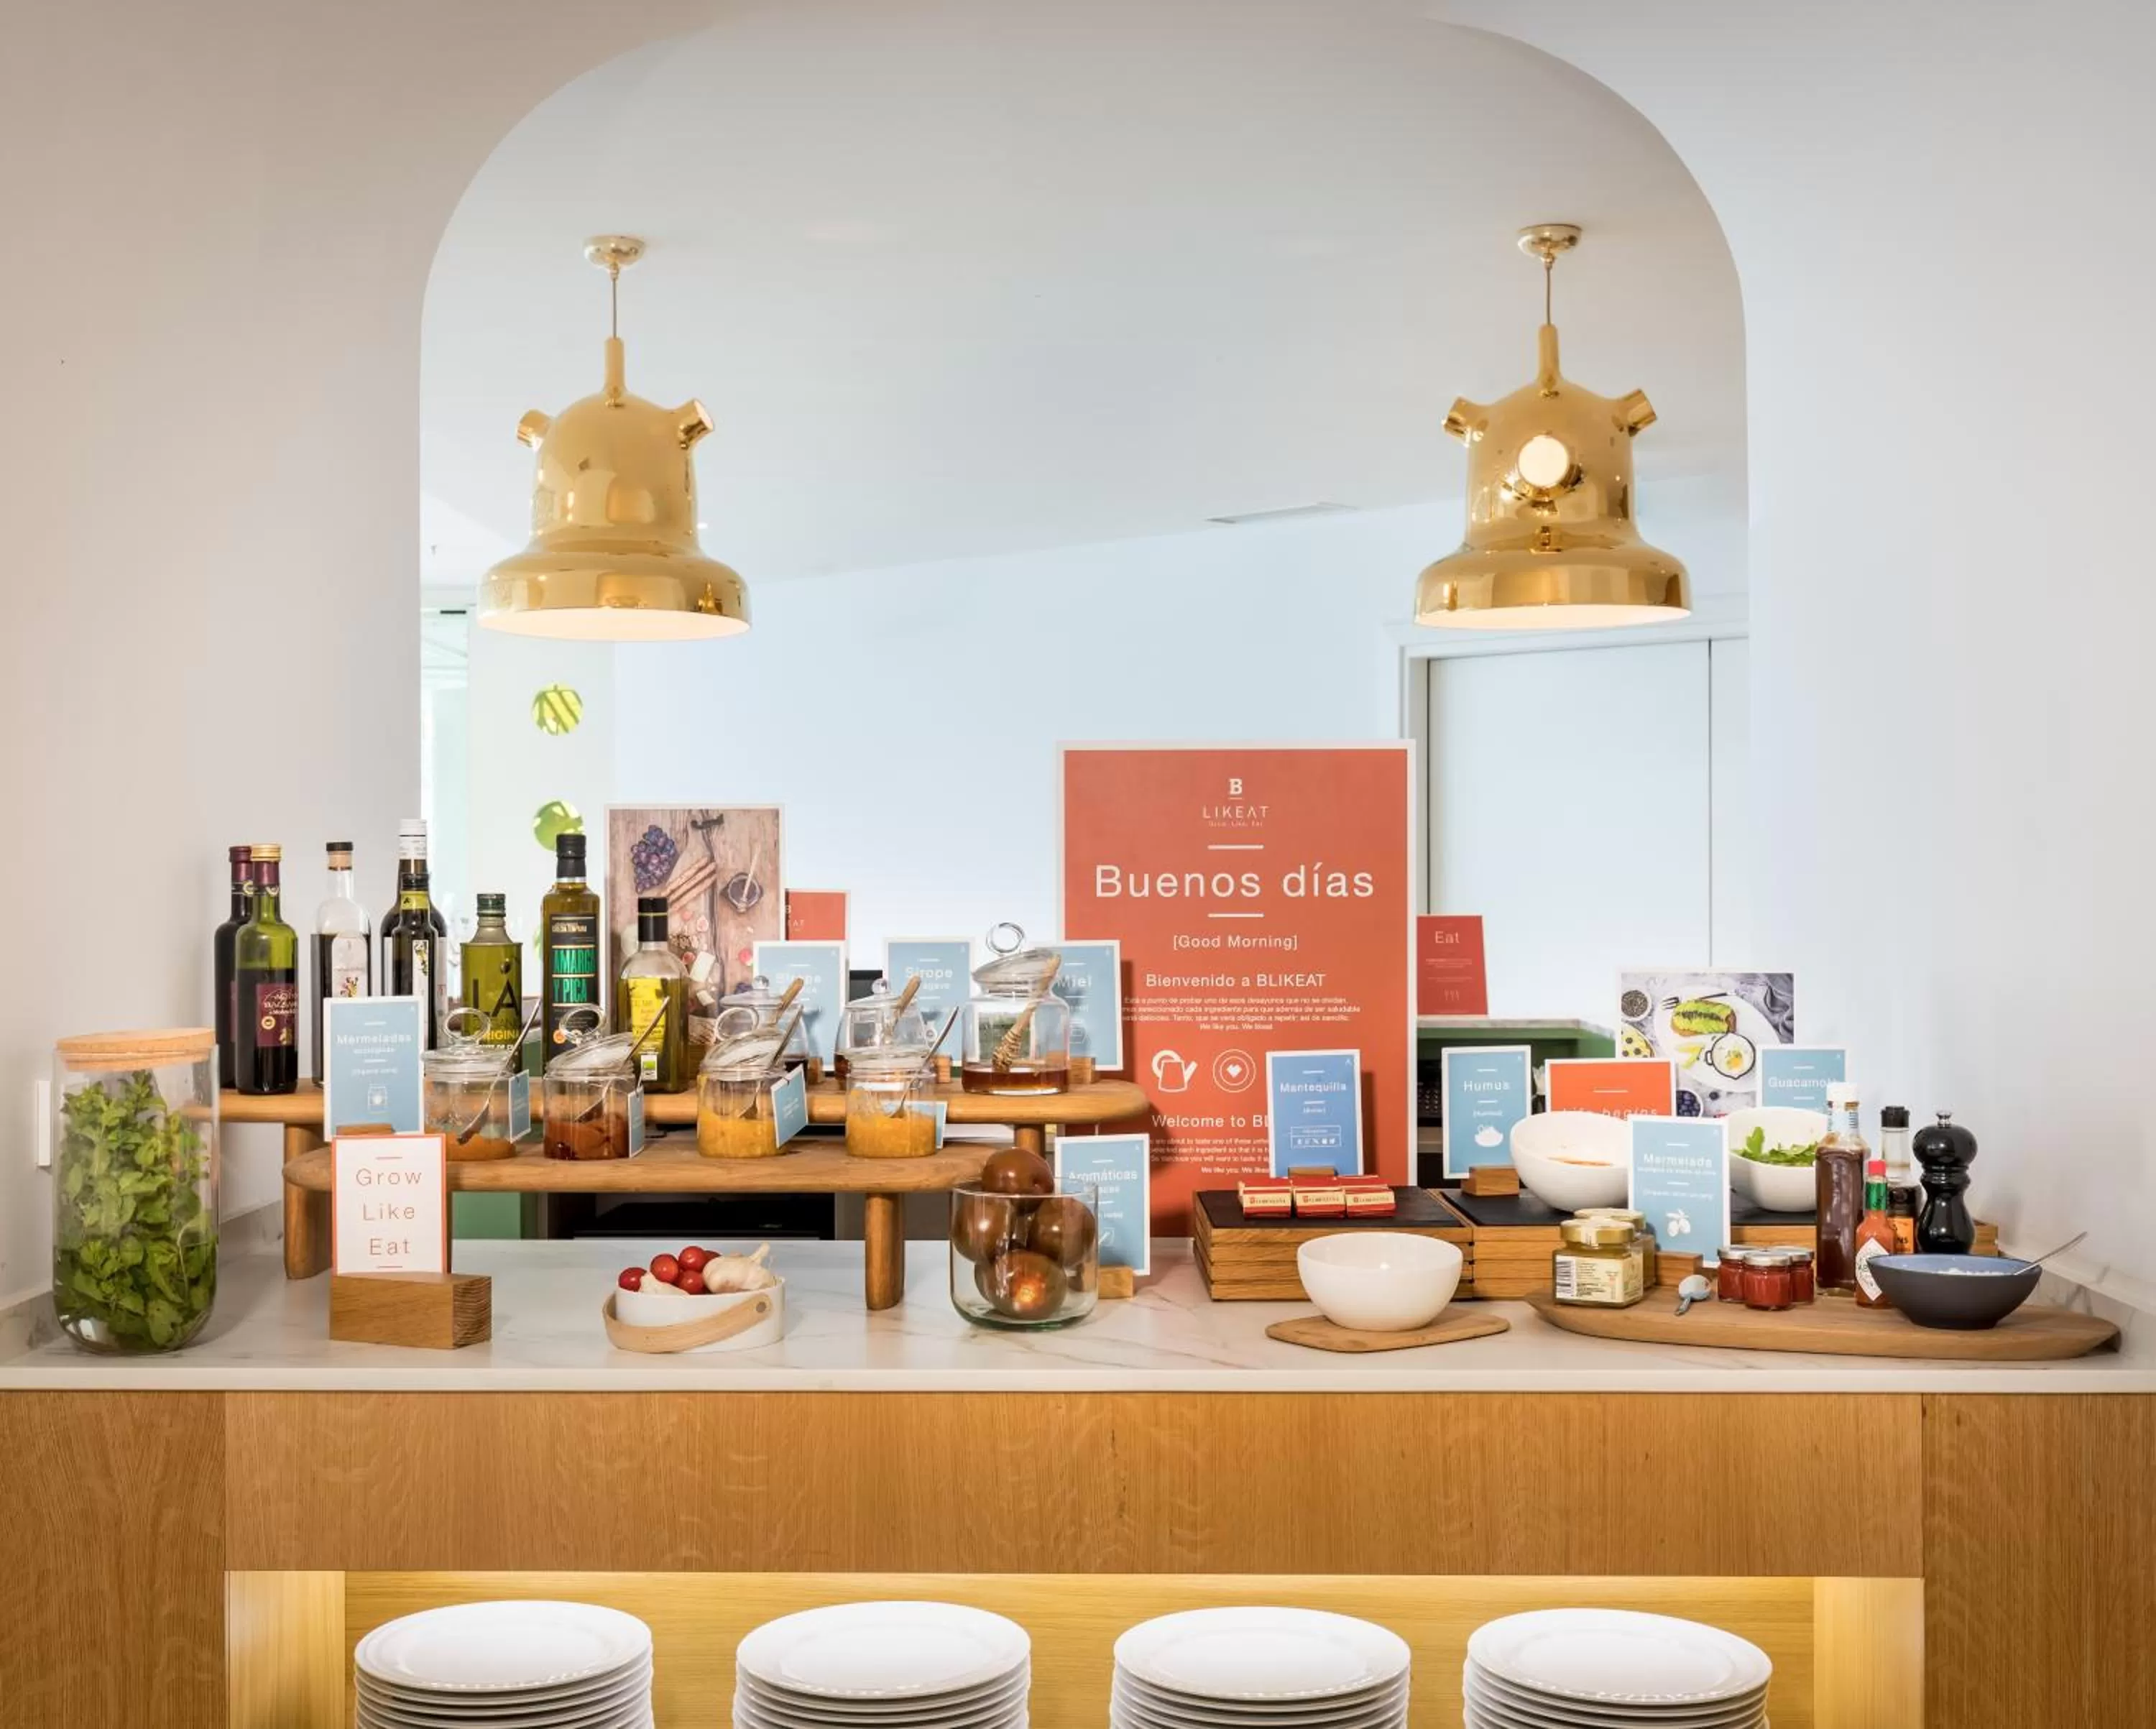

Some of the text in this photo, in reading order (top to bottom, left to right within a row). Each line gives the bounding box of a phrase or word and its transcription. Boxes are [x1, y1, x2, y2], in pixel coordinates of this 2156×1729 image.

[1228, 778, 1243, 796] B
[1202, 805, 1271, 819] LIKEAT
[1095, 862, 1374, 898] Buenos días
[1173, 935, 1298, 950] [Good Morning]
[1434, 931, 1460, 944] Eat
[1058, 974, 1092, 987] Miel
[1146, 974, 1326, 987] Bienvenido a BLIKEAT
[563, 979, 588, 1003] PICA
[1280, 1082, 1347, 1093] Mantequilla
[1463, 1080, 1511, 1092] Humus
[1769, 1076, 1836, 1088] Guacamol
[1152, 1115, 1224, 1128] Welcome
[1230, 1115, 1246, 1128] to
[356, 1168, 423, 1186] Grow
[363, 1203, 415, 1220] Like
[369, 1238, 411, 1256] Eat
